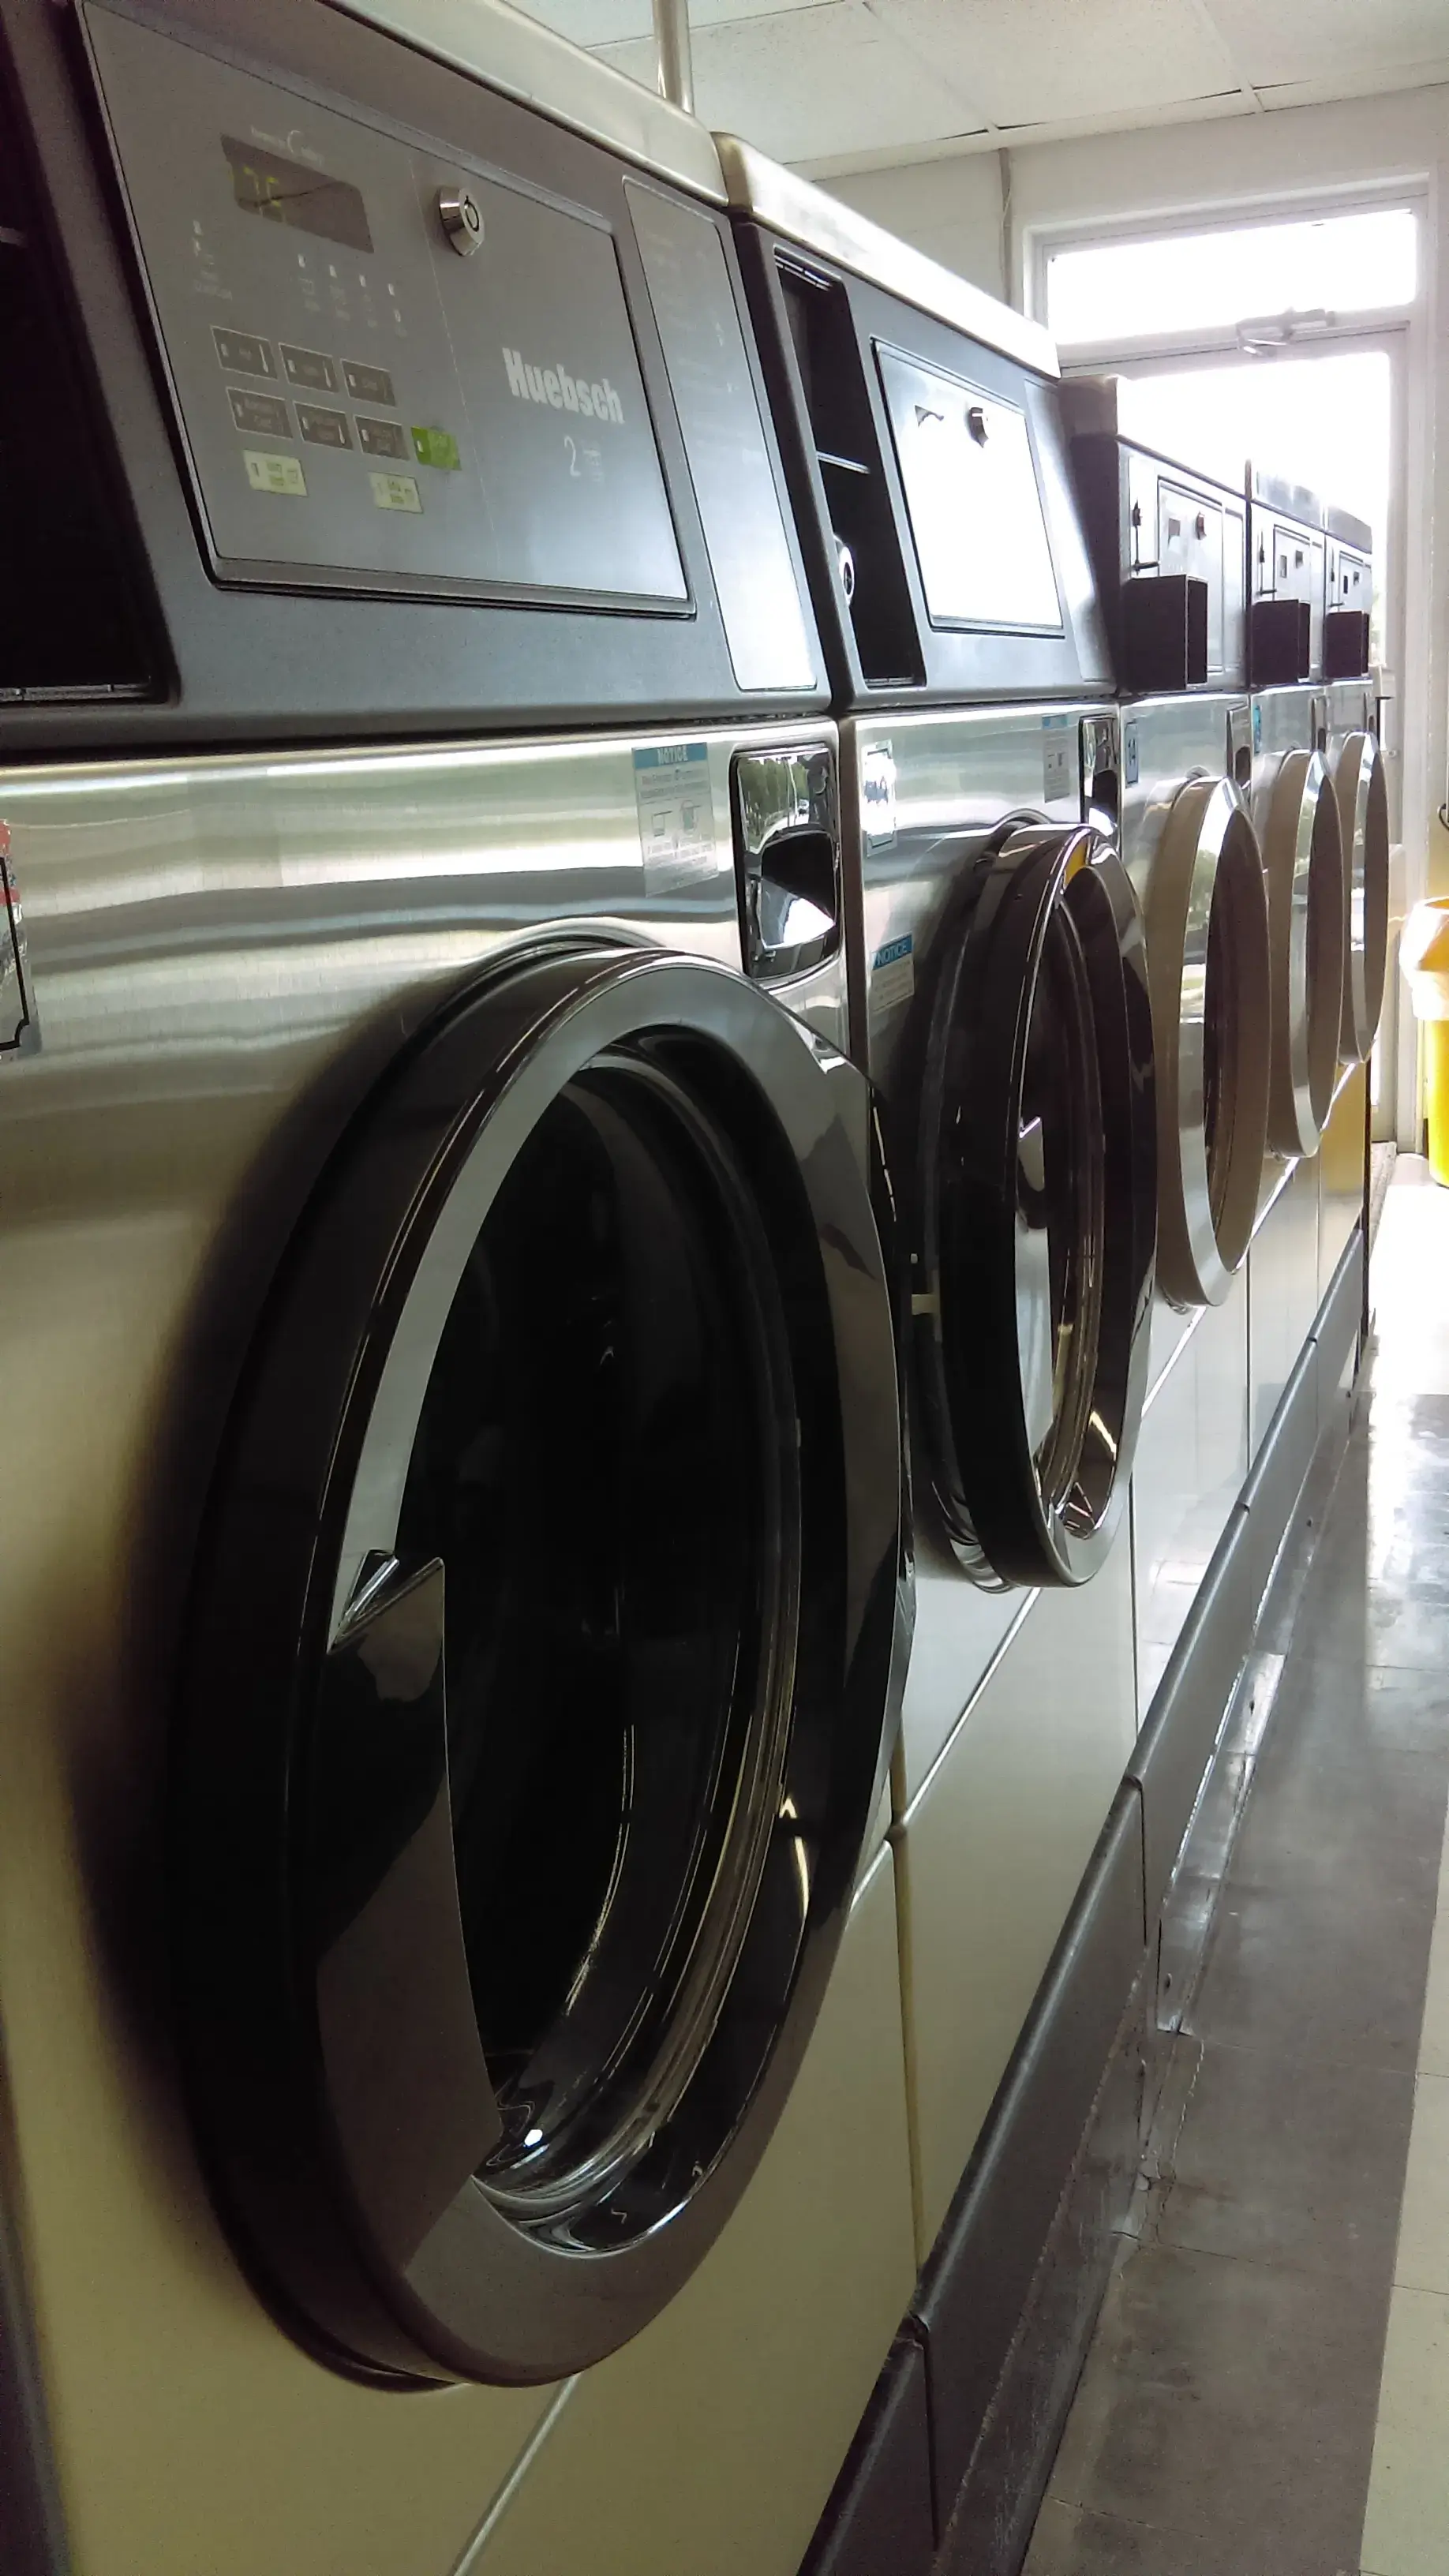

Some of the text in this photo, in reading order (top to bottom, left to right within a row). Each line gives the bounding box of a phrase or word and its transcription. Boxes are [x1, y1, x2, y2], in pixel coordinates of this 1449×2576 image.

[502, 347, 626, 425] Huebsch
[563, 435, 582, 477] 2
[657, 745, 689, 766] NOTICE
[876, 943, 908, 966] NOTICE
